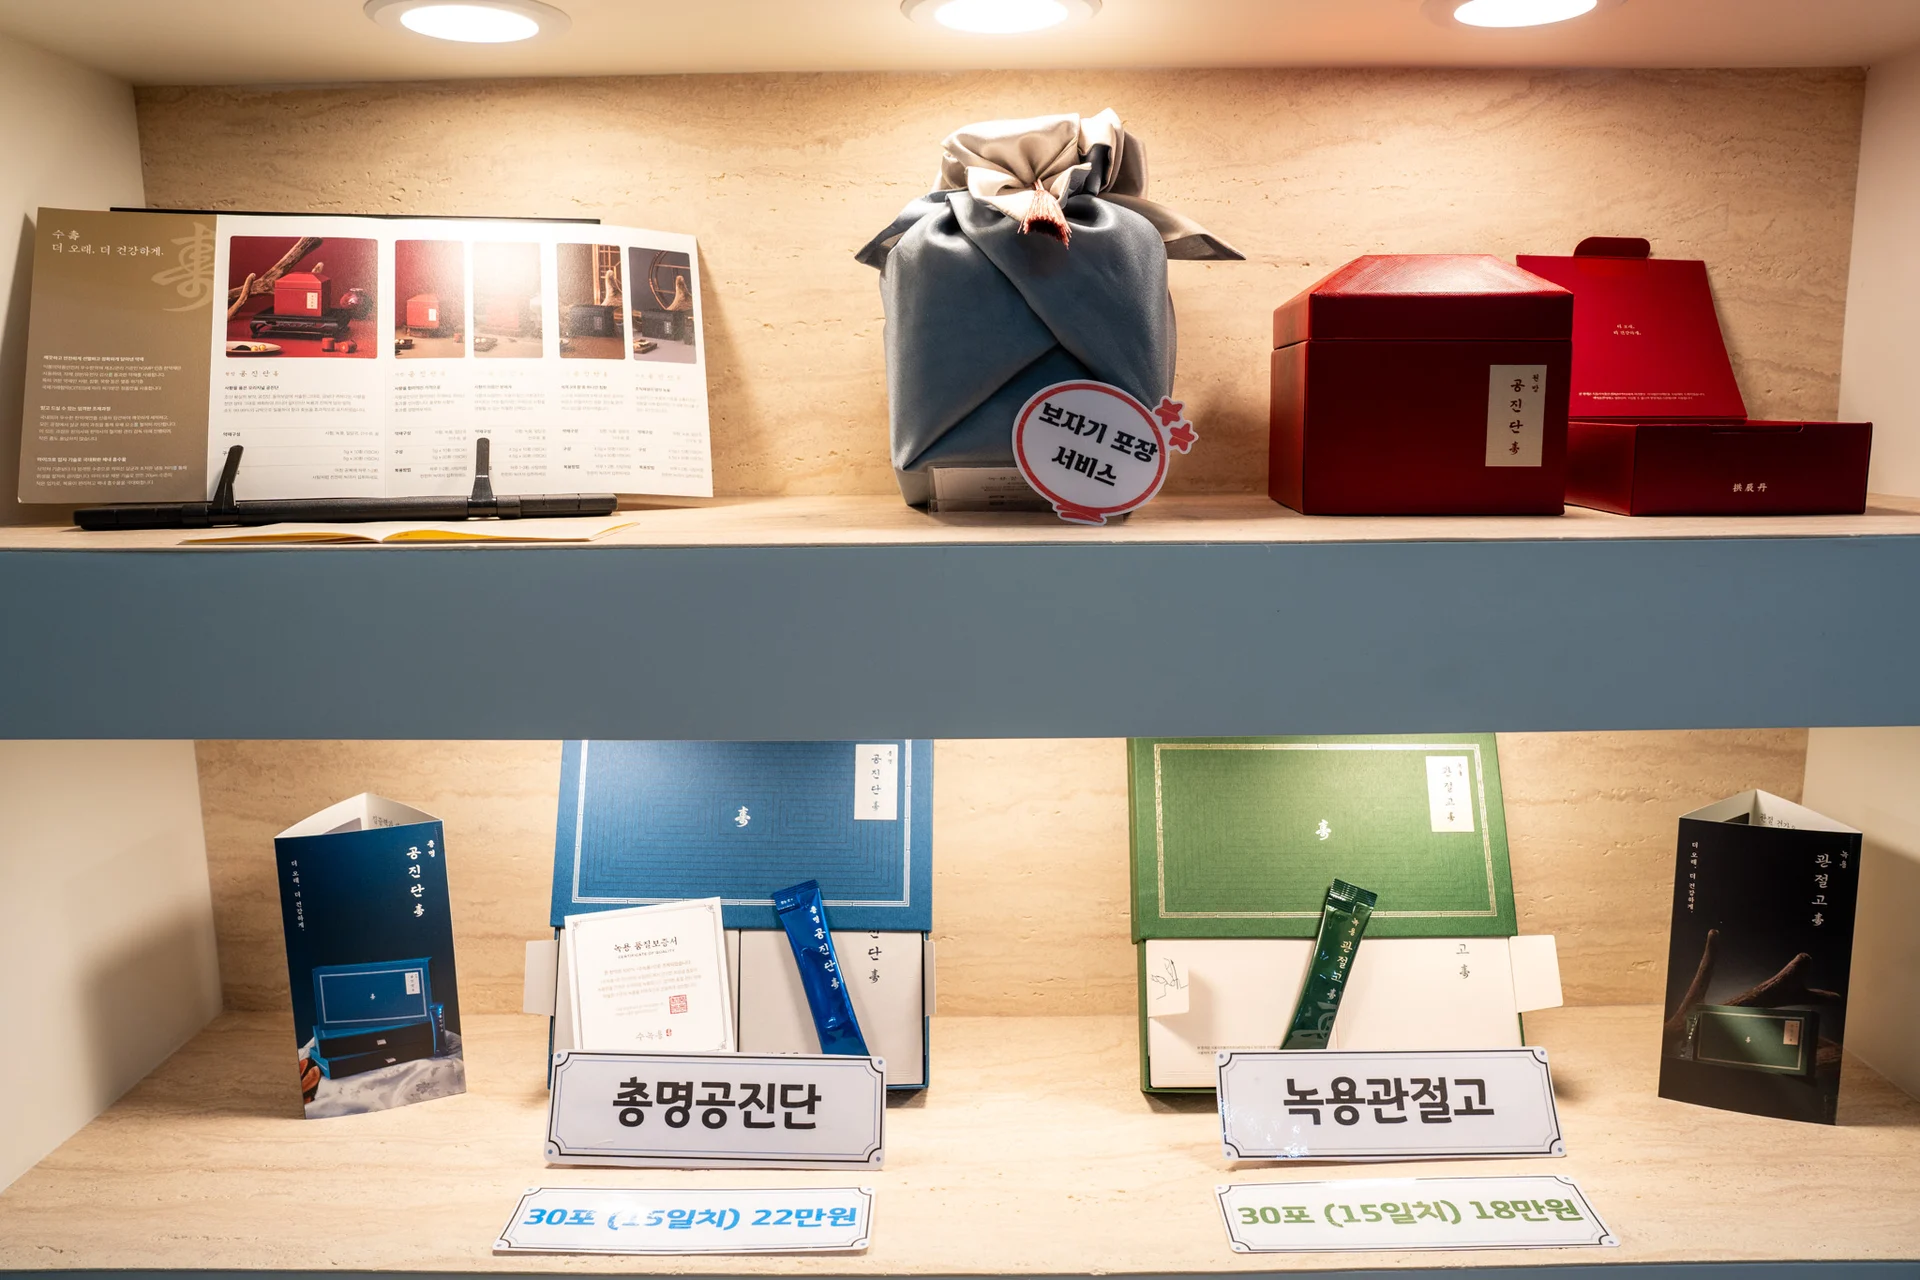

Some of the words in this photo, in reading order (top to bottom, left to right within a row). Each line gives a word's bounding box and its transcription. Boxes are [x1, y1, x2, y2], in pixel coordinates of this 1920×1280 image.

[52, 243, 63, 253] 더
[100, 245, 111, 255] 더
[1038, 402, 1108, 444] 보자기
[1110, 430, 1158, 463] 포장
[1052, 445, 1117, 487] 서비스
[612, 1076, 822, 1130] 총명공진단
[1282, 1075, 1495, 1126] 녹용관절고
[523, 1207, 598, 1227] 30포
[750, 1206, 858, 1228] 22만원
[1237, 1204, 1315, 1226] 30포
[1323, 1199, 1462, 1228] (15일치)
[1471, 1197, 1584, 1223] 18만원
